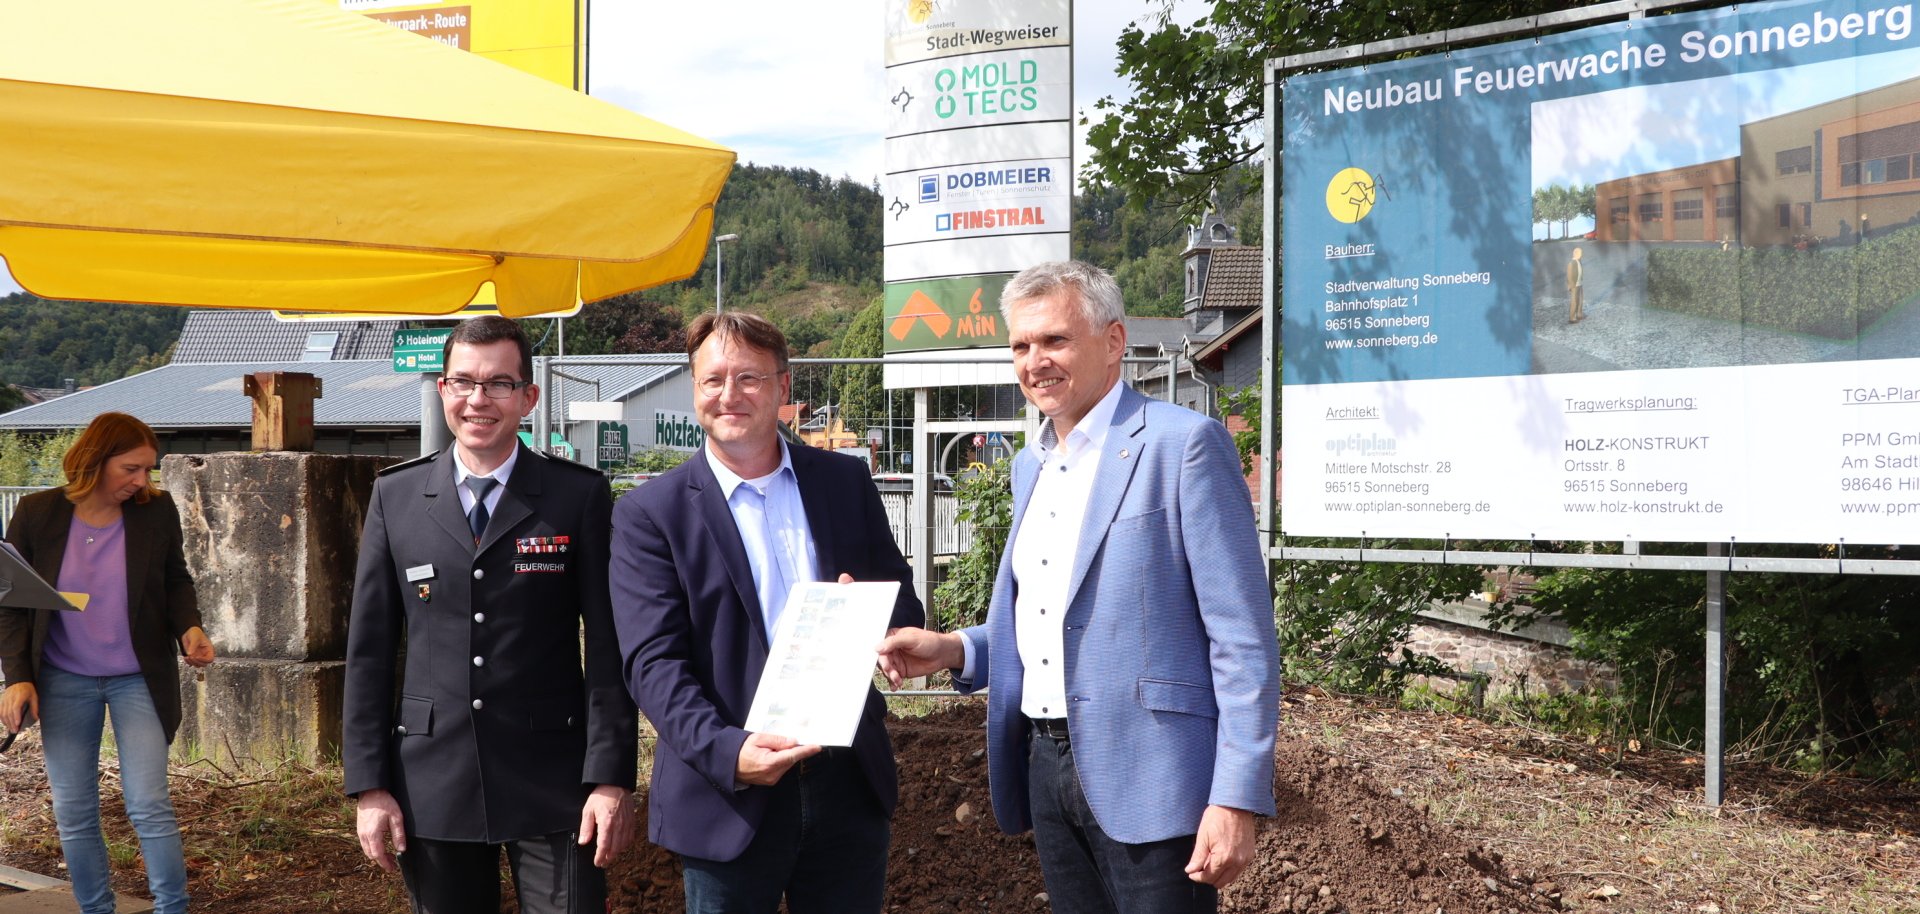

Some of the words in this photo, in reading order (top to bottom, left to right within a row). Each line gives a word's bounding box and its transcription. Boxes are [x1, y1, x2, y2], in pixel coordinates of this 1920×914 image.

[376, 13, 467, 32] rpark-Route
[926, 21, 956, 30] Sonneberg
[926, 24, 1059, 51] Stadt-Wegweiser
[1324, 79, 1442, 116] Neubau
[1455, 40, 1667, 97] Feuerwache
[1679, 3, 1912, 63] Sonneberg
[962, 60, 1038, 90] MOLD
[963, 86, 1038, 116] TECS
[947, 167, 1051, 190] DOBMEIER
[952, 207, 1045, 230] FINSTRAL
[1325, 242, 1375, 257] Bauherr:
[1325, 277, 1419, 294] Stadtverwaltung
[1423, 271, 1491, 287] Sonneberg
[969, 287, 983, 314] 6
[1325, 297, 1408, 313] Bahnhofsplatz
[1412, 294, 1419, 306] 1
[1325, 317, 1361, 330] 96515
[1365, 314, 1430, 328] Sonneberg
[406, 333, 450, 346] Hotelrout
[1325, 332, 1438, 350] www.sonneberg.de
[418, 353, 436, 362] Hotel
[1326, 406, 1379, 418] Architekt:
[1565, 396, 1697, 413] Tragwerksplanung:
[604, 430, 621, 444] HOLZ
[1325, 432, 1397, 457] optiplan
[1565, 437, 1709, 451] HOLZ-KONSTRUKT
[1842, 432, 1881, 446] PPM
[1887, 431, 1920, 446] Gm
[1325, 462, 1367, 474] Mittlere
[1371, 462, 1432, 474] Motschstr.
[1436, 461, 1452, 473] 28
[1564, 459, 1612, 472] Ortsstr.
[1617, 459, 1625, 472] 8
[1842, 455, 1868, 469] Am
[1874, 454, 1920, 469] Stadt
[1325, 482, 1361, 493] 96515
[1364, 481, 1429, 495] Sonneberg
[1564, 480, 1605, 493] 96515
[1610, 480, 1688, 495] Sonneberg
[1841, 477, 1892, 491] 98646
[1325, 501, 1491, 515] www.optiplan-sonneberg.de
[1564, 501, 1723, 514] www.holz-konstrukt.de
[514, 563, 565, 572] FEUERWEHR
